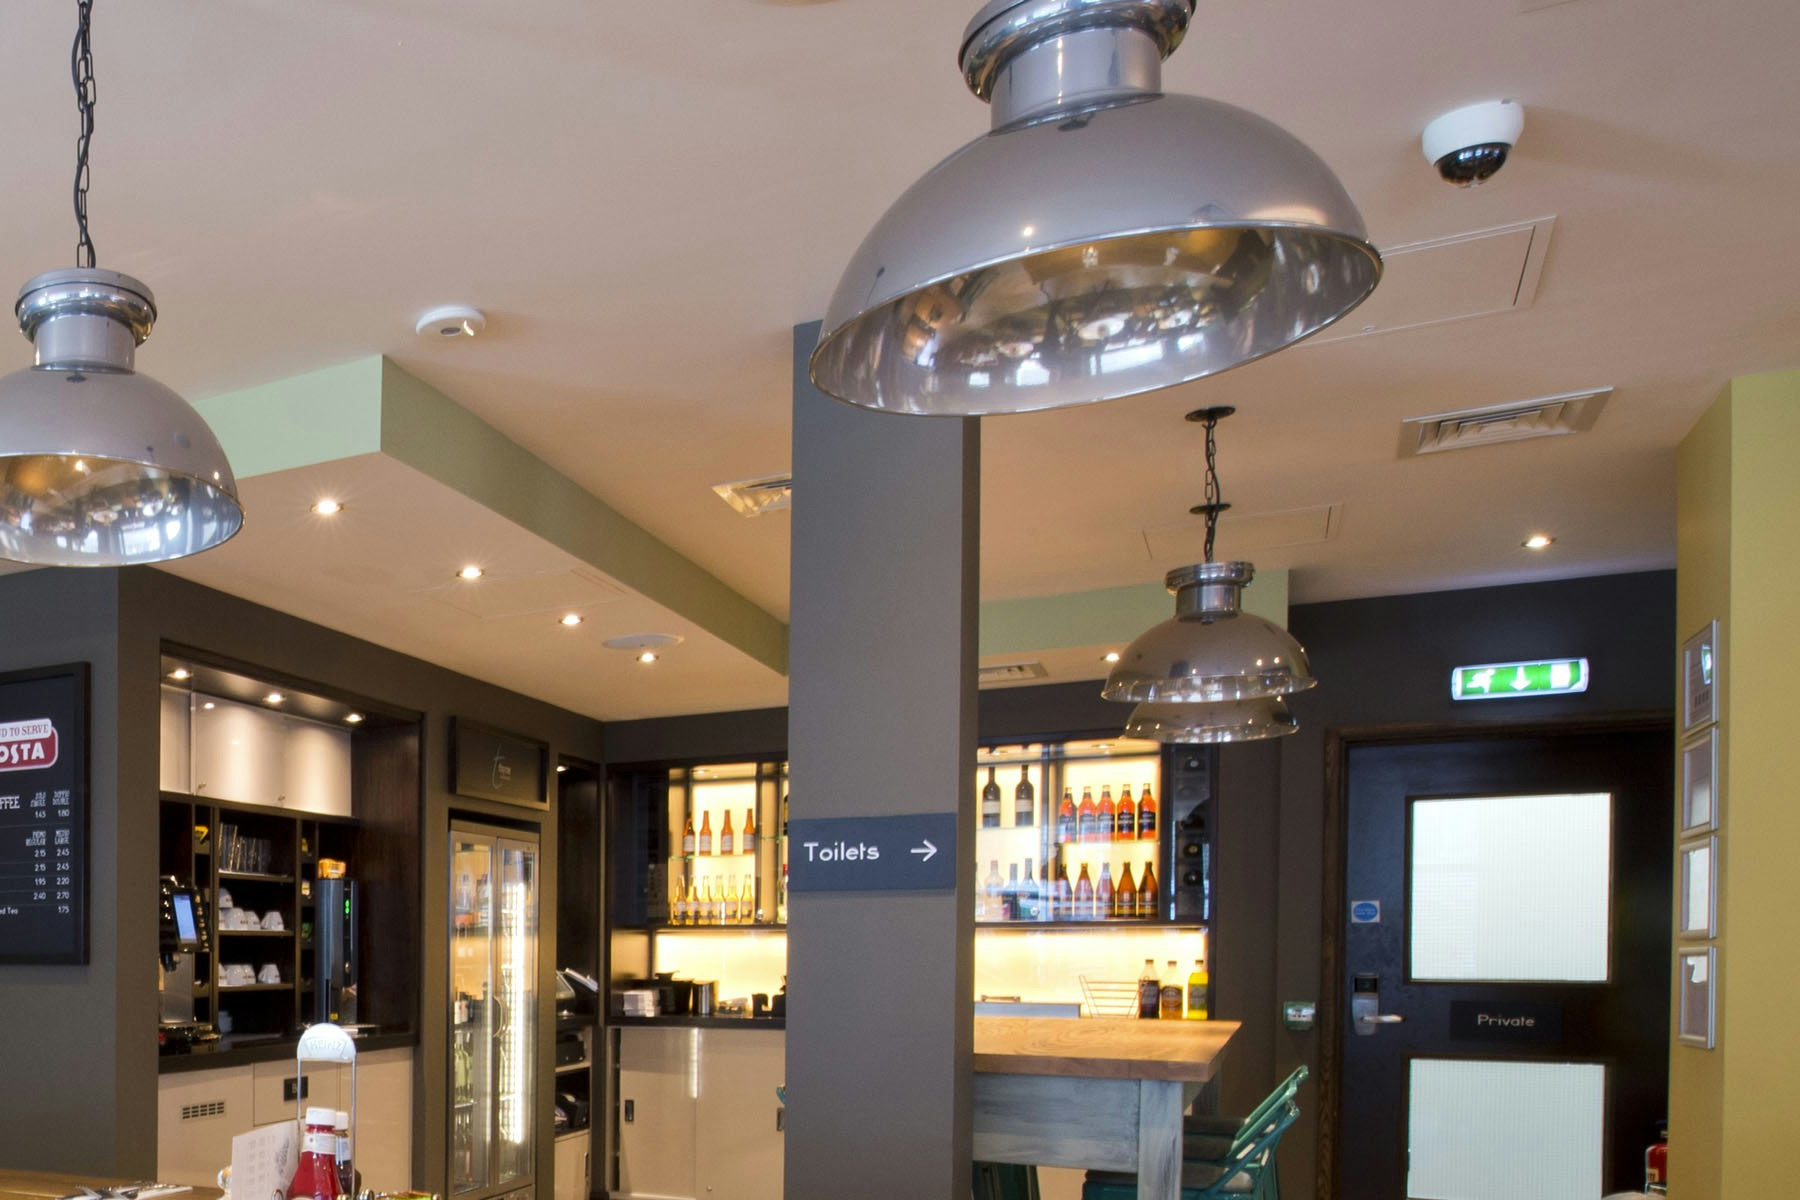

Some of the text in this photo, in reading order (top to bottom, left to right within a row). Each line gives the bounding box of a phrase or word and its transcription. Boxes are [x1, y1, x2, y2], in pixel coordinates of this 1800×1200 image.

[10, 727, 20, 737] TO
[21, 724, 49, 736] SERVE
[803, 841, 880, 862] Toilets
[1477, 1013, 1535, 1027] Private
